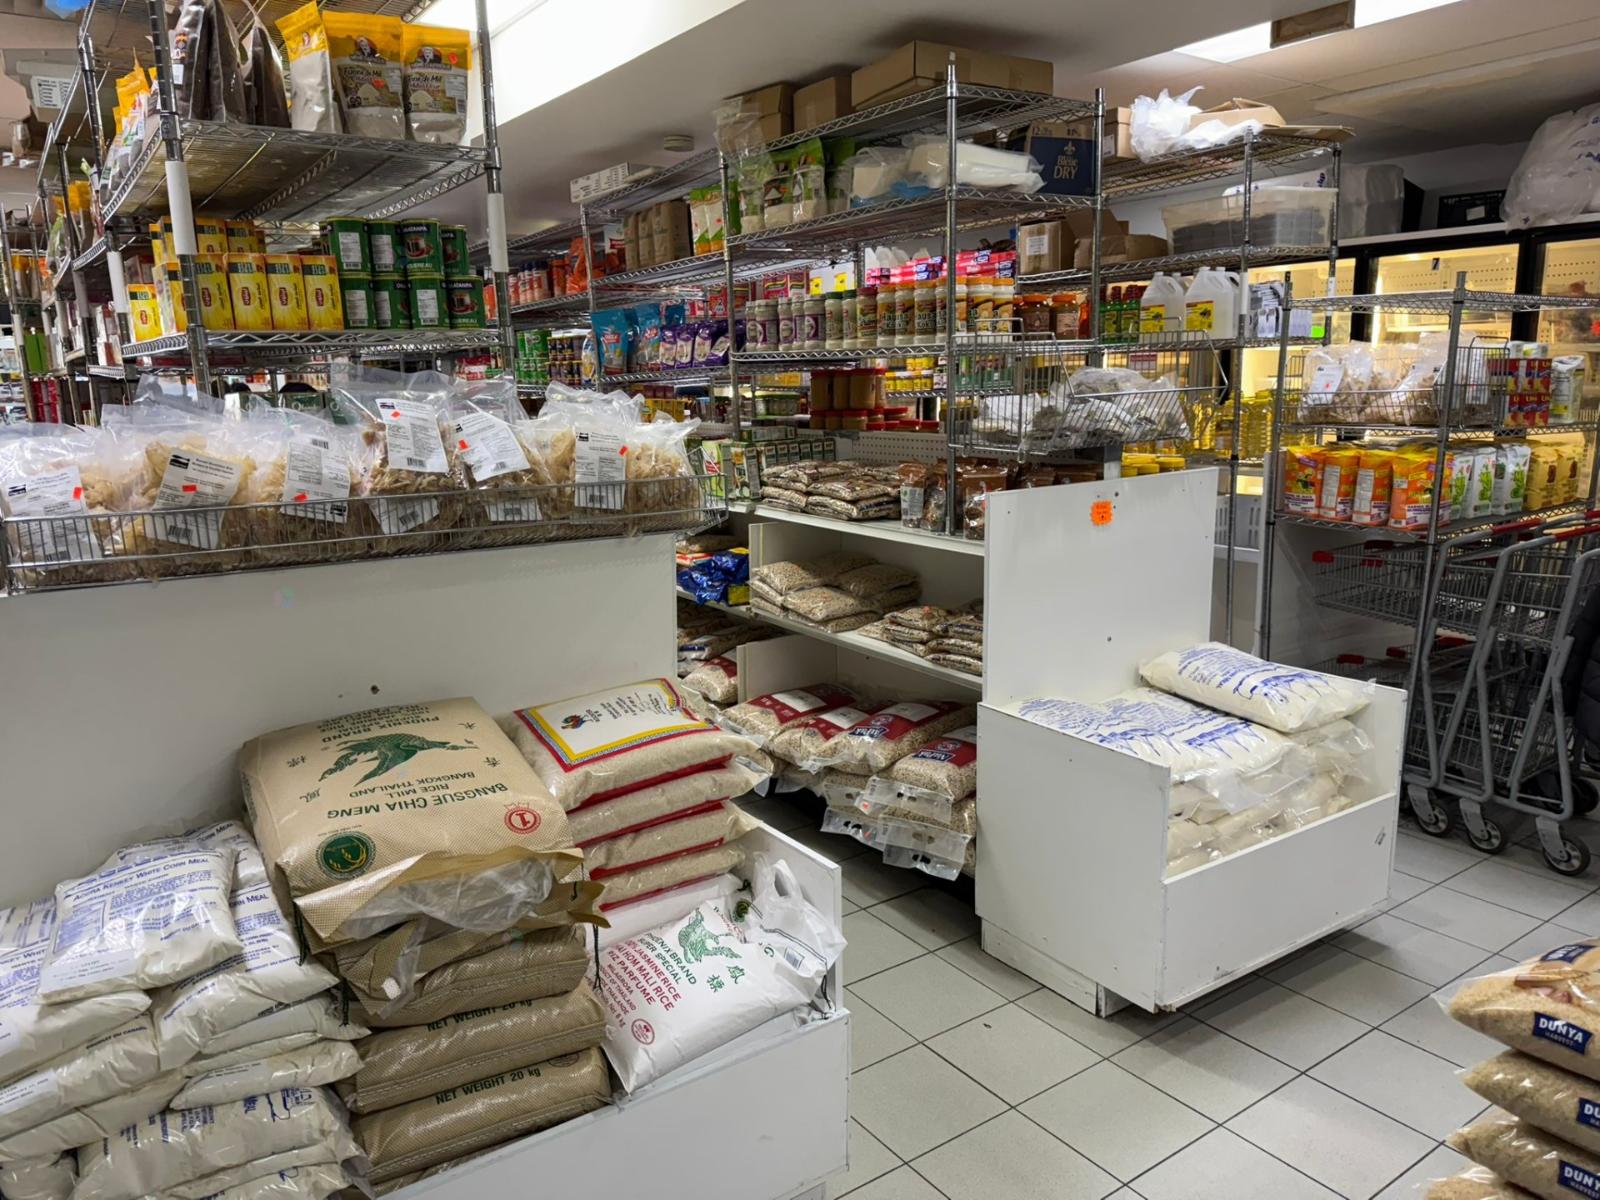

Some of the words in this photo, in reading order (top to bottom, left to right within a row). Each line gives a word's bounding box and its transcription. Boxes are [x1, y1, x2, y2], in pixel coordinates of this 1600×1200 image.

[1054, 166, 1078, 179] DRY
[1432, 258, 1440, 271] 7
[378, 715, 440, 730] PHOENIX
[322, 727, 372, 743] BRAND
[417, 771, 476, 786] BANGKOK
[350, 779, 415, 798] THAILAND
[387, 787, 417, 799] MILL
[420, 783, 450, 794] RICE
[434, 782, 508, 806] BANGSUE
[327, 804, 380, 820] MENG
[386, 797, 429, 812] CHIA
[246, 893, 269, 903] MEAL
[23, 949, 46, 959] WHIT
[636, 947, 665, 980] JASMINE
[660, 973, 682, 1002] RICE
[655, 952, 682, 985] SPECIAL
[669, 951, 697, 985] BRAND
[607, 963, 634, 996] MILAGROSA
[617, 959, 657, 1006] PARFUME
[622, 948, 640, 968] HOM
[636, 961, 657, 987] MALI
[652, 983, 675, 1012] RICE
[615, 981, 638, 1012] THAILAND
[427, 1019, 449, 1032] NET
[451, 1006, 496, 1025] WEIGHT
[1539, 1017, 1583, 1043] DUNYA
[435, 1091, 458, 1105] NET
[462, 1075, 506, 1096] WEIGHT
[511, 1070, 524, 1082] 20
[528, 1067, 541, 1077] kg
